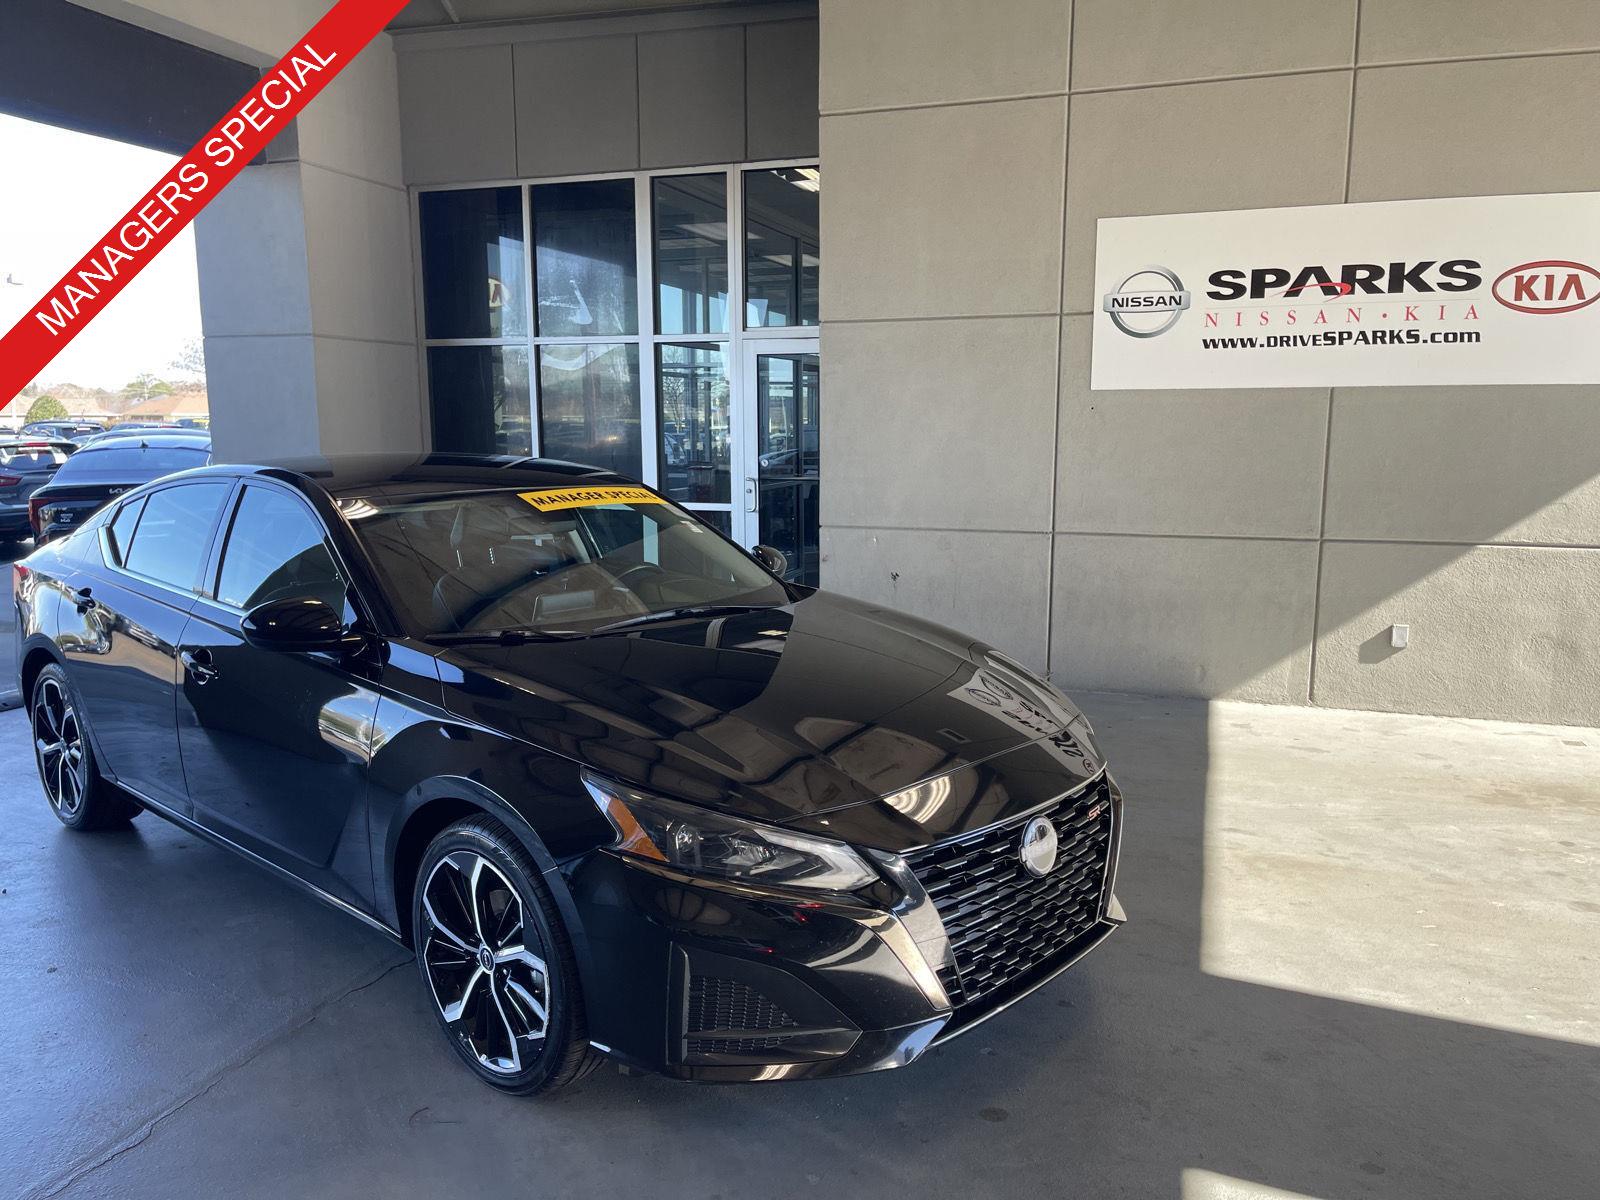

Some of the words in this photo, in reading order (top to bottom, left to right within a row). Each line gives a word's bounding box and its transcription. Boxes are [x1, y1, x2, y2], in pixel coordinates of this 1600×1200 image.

[1206, 259, 1482, 301] SPARKS
[1513, 273, 1587, 302] KIA
[1111, 295, 1182, 308] NISSAN
[531, 490, 607, 506] MANAGER
[604, 490, 659, 500] SPECIAL
